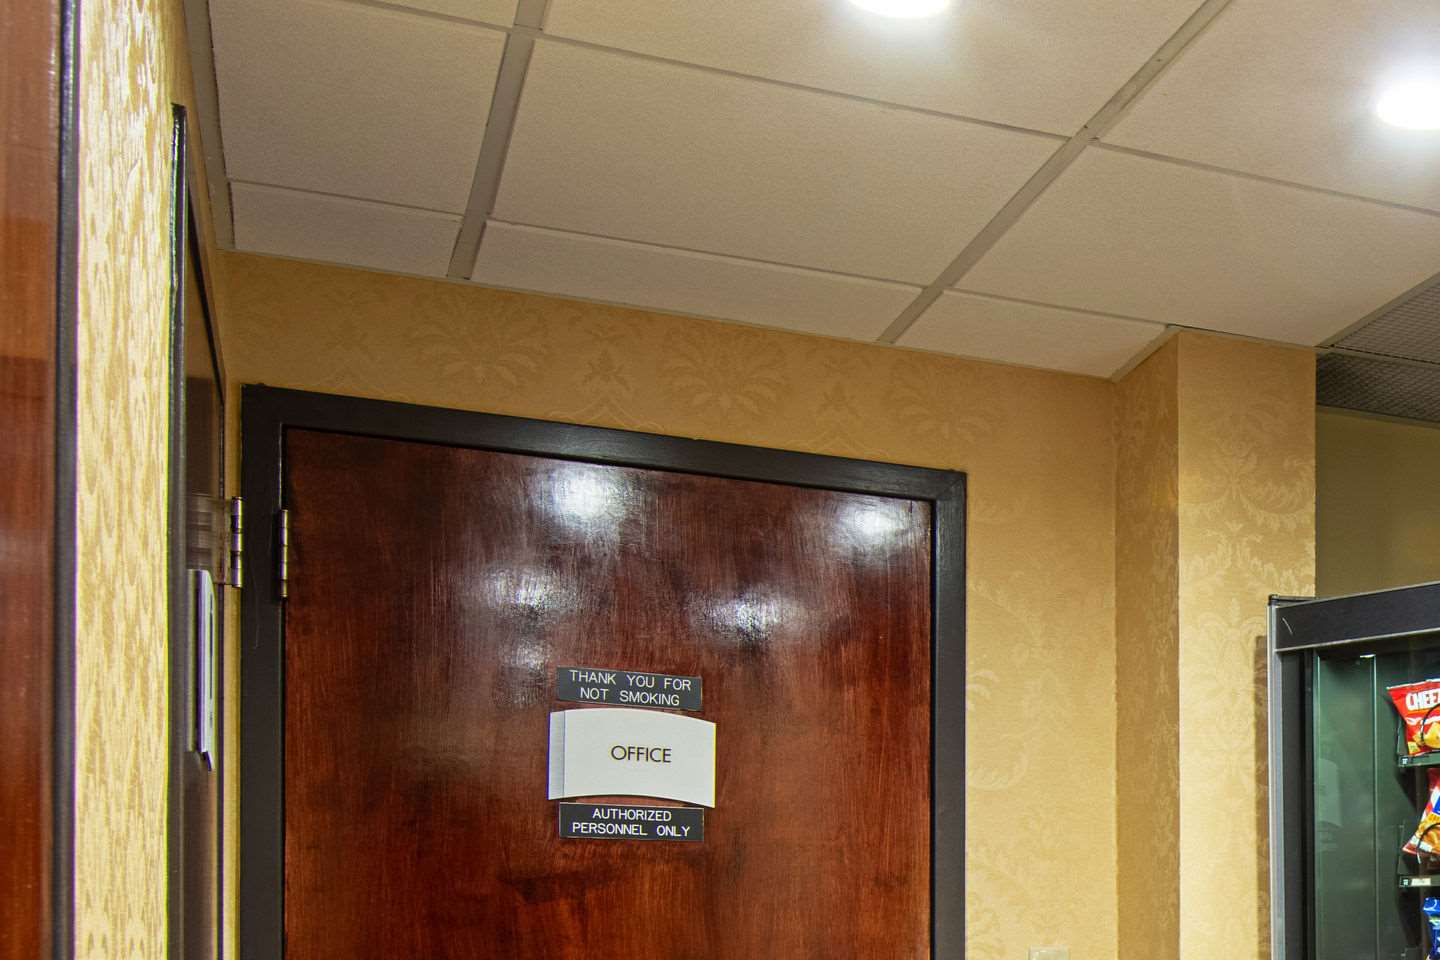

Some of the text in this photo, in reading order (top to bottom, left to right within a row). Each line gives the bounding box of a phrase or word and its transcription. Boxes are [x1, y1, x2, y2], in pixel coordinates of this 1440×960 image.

[569, 669, 691, 691] THANK YOU FOR
[580, 687, 680, 706] NOT SMOKING
[611, 745, 672, 763] OFFICE
[592, 808, 672, 821] AUTHORIZED
[572, 822, 691, 837] PERSONNEL ONLY
